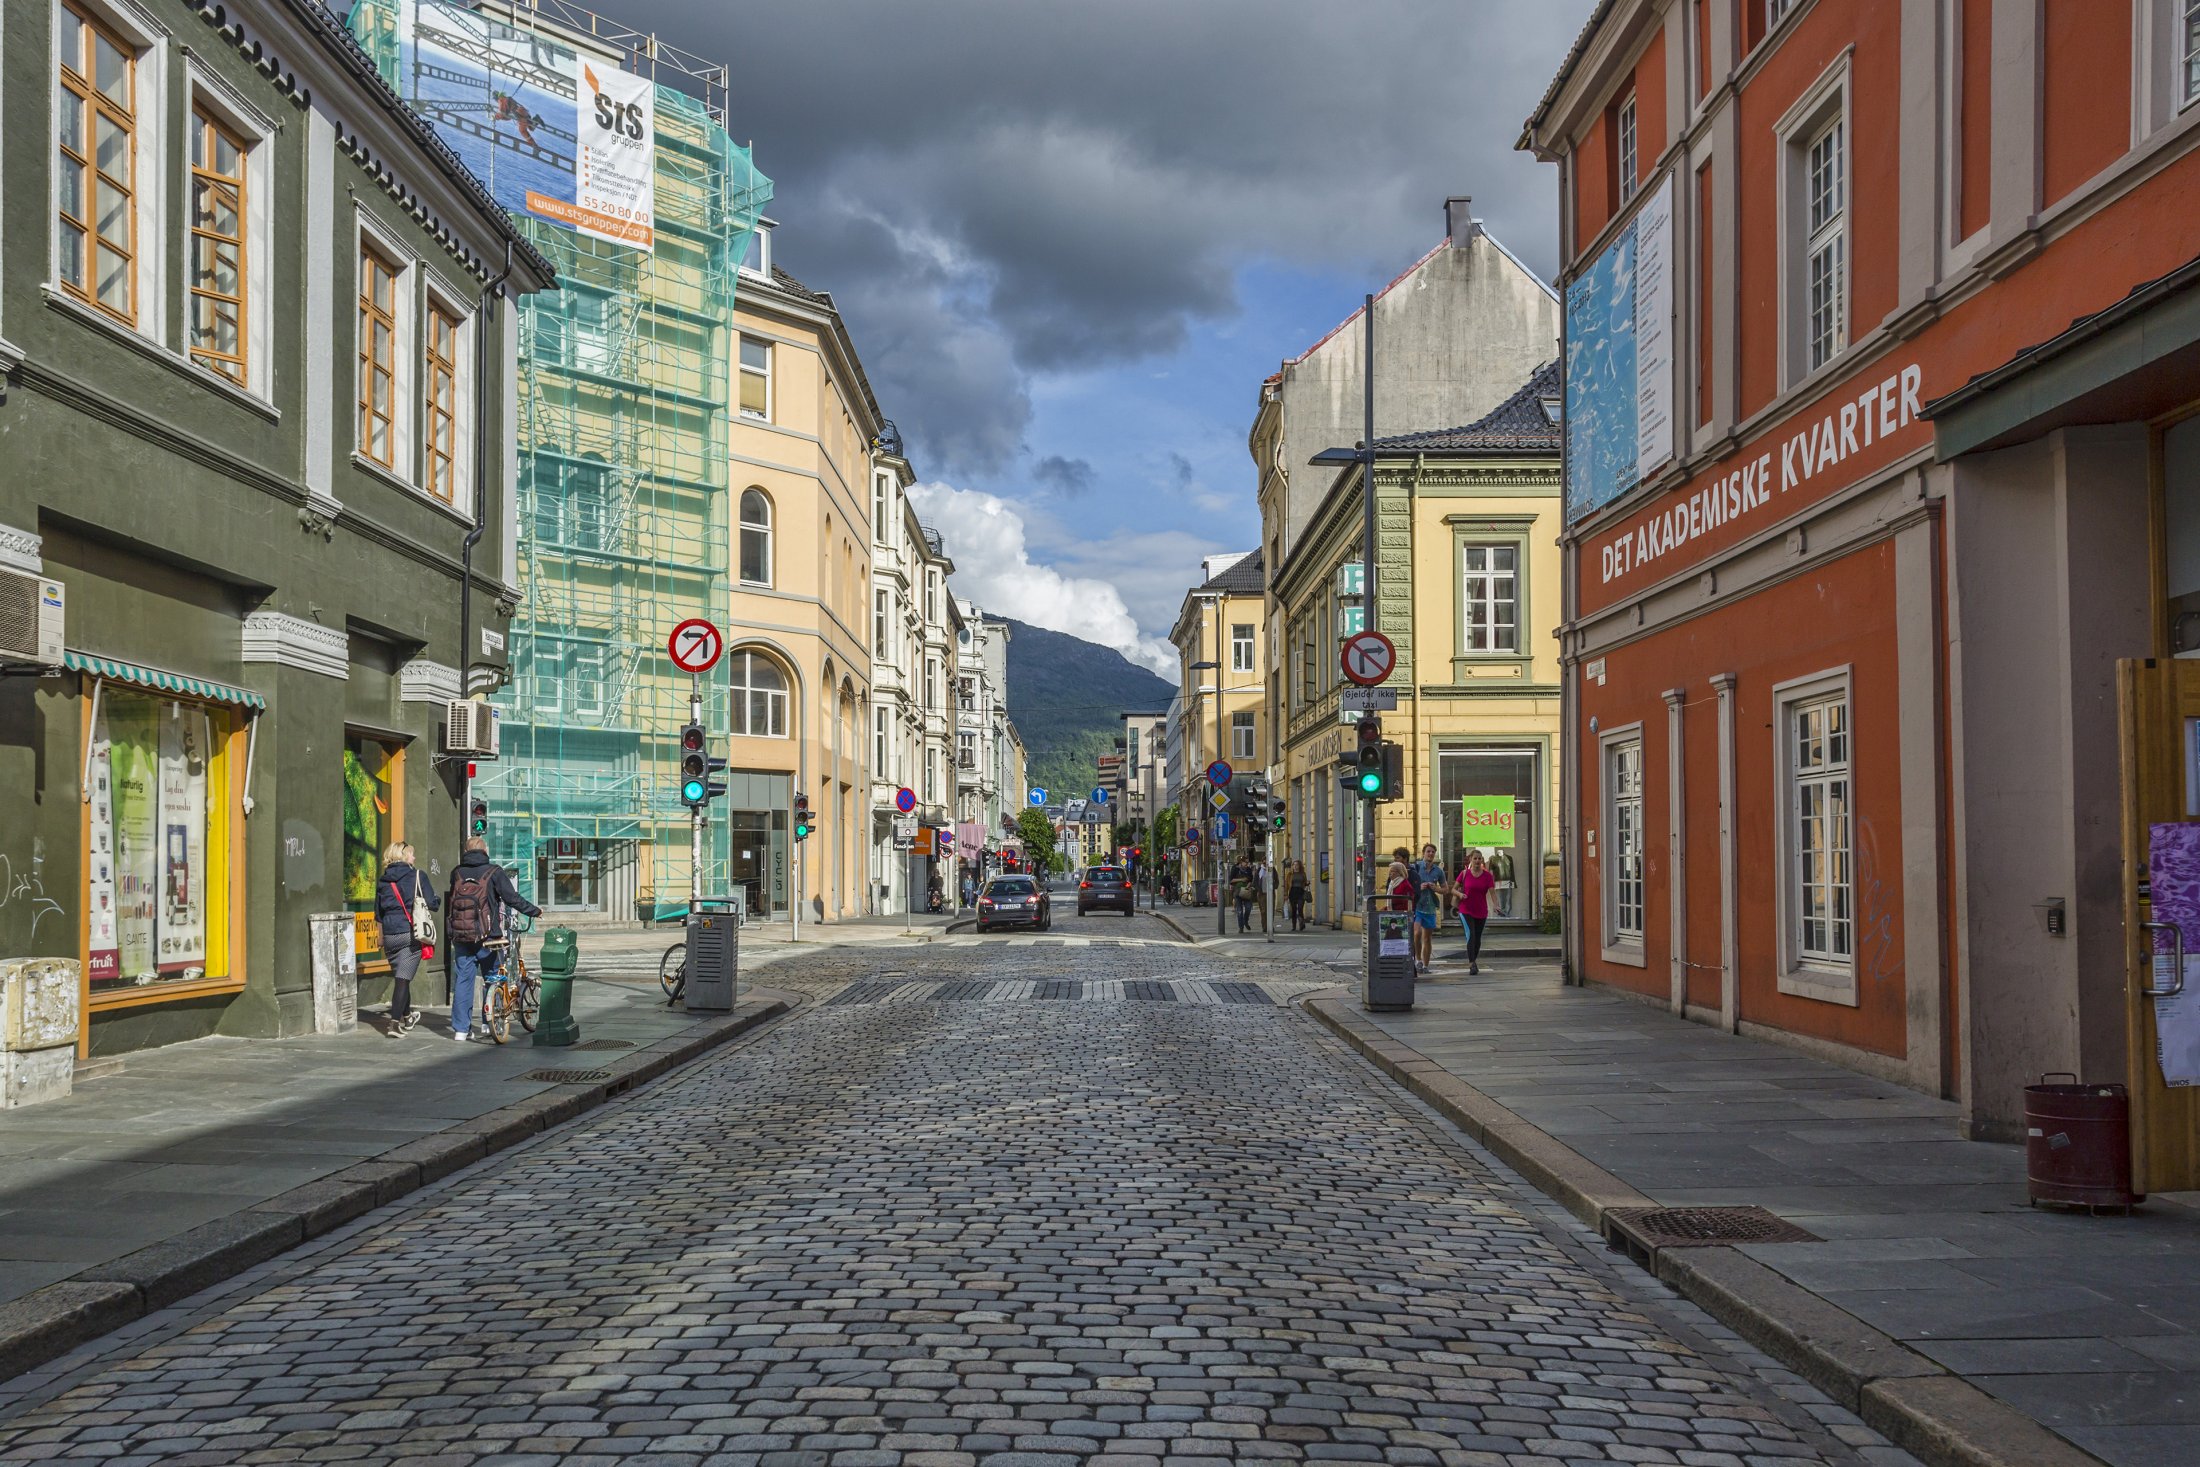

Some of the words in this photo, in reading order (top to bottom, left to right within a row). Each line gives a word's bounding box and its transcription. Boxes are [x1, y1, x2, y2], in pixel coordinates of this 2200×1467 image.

[611, 134, 643, 152] gruppen
[534, 197, 649, 240] www.stsgruppen.com
[584, 196, 598, 209] 55
[601, 201, 615, 214] 20
[618, 206, 632, 219] 80
[635, 211, 649, 223] 00
[1602, 531, 1634, 585] DET
[1634, 452, 1771, 568] AKADEMISKE
[1781, 362, 1922, 493] KVARTER
[1345, 690, 1375, 700] Gjelder
[1378, 690, 1395, 698] ikke
[1362, 700, 1378, 709] taxi
[1466, 808, 1512, 831] Salg
[126, 932, 148, 946] SANTE
